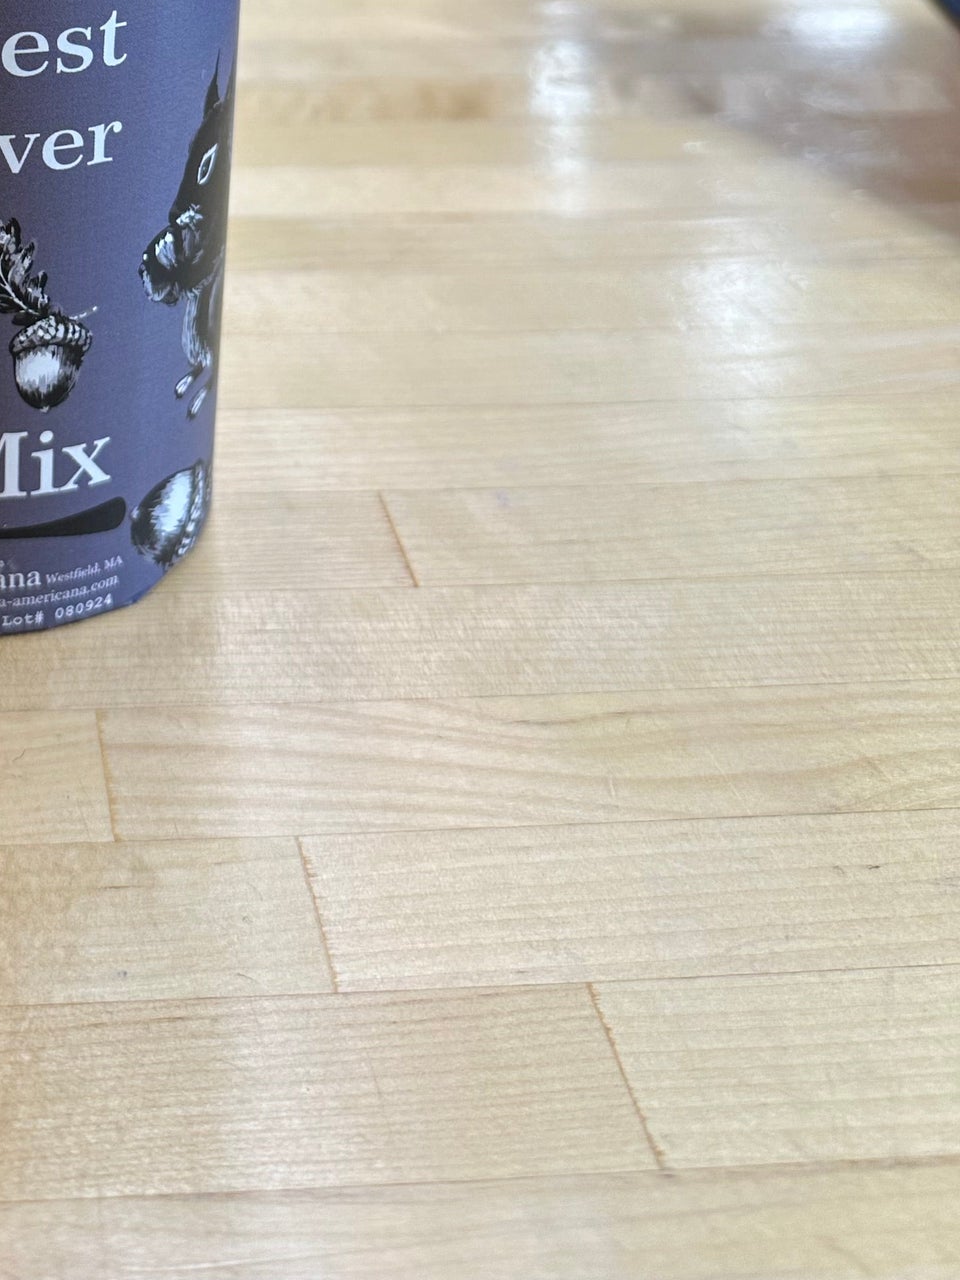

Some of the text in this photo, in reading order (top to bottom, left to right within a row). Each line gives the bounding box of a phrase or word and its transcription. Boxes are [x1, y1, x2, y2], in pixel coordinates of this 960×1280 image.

[104, 555, 123, 570] MA
[2, 593, 113, 627] Lot# 080924
